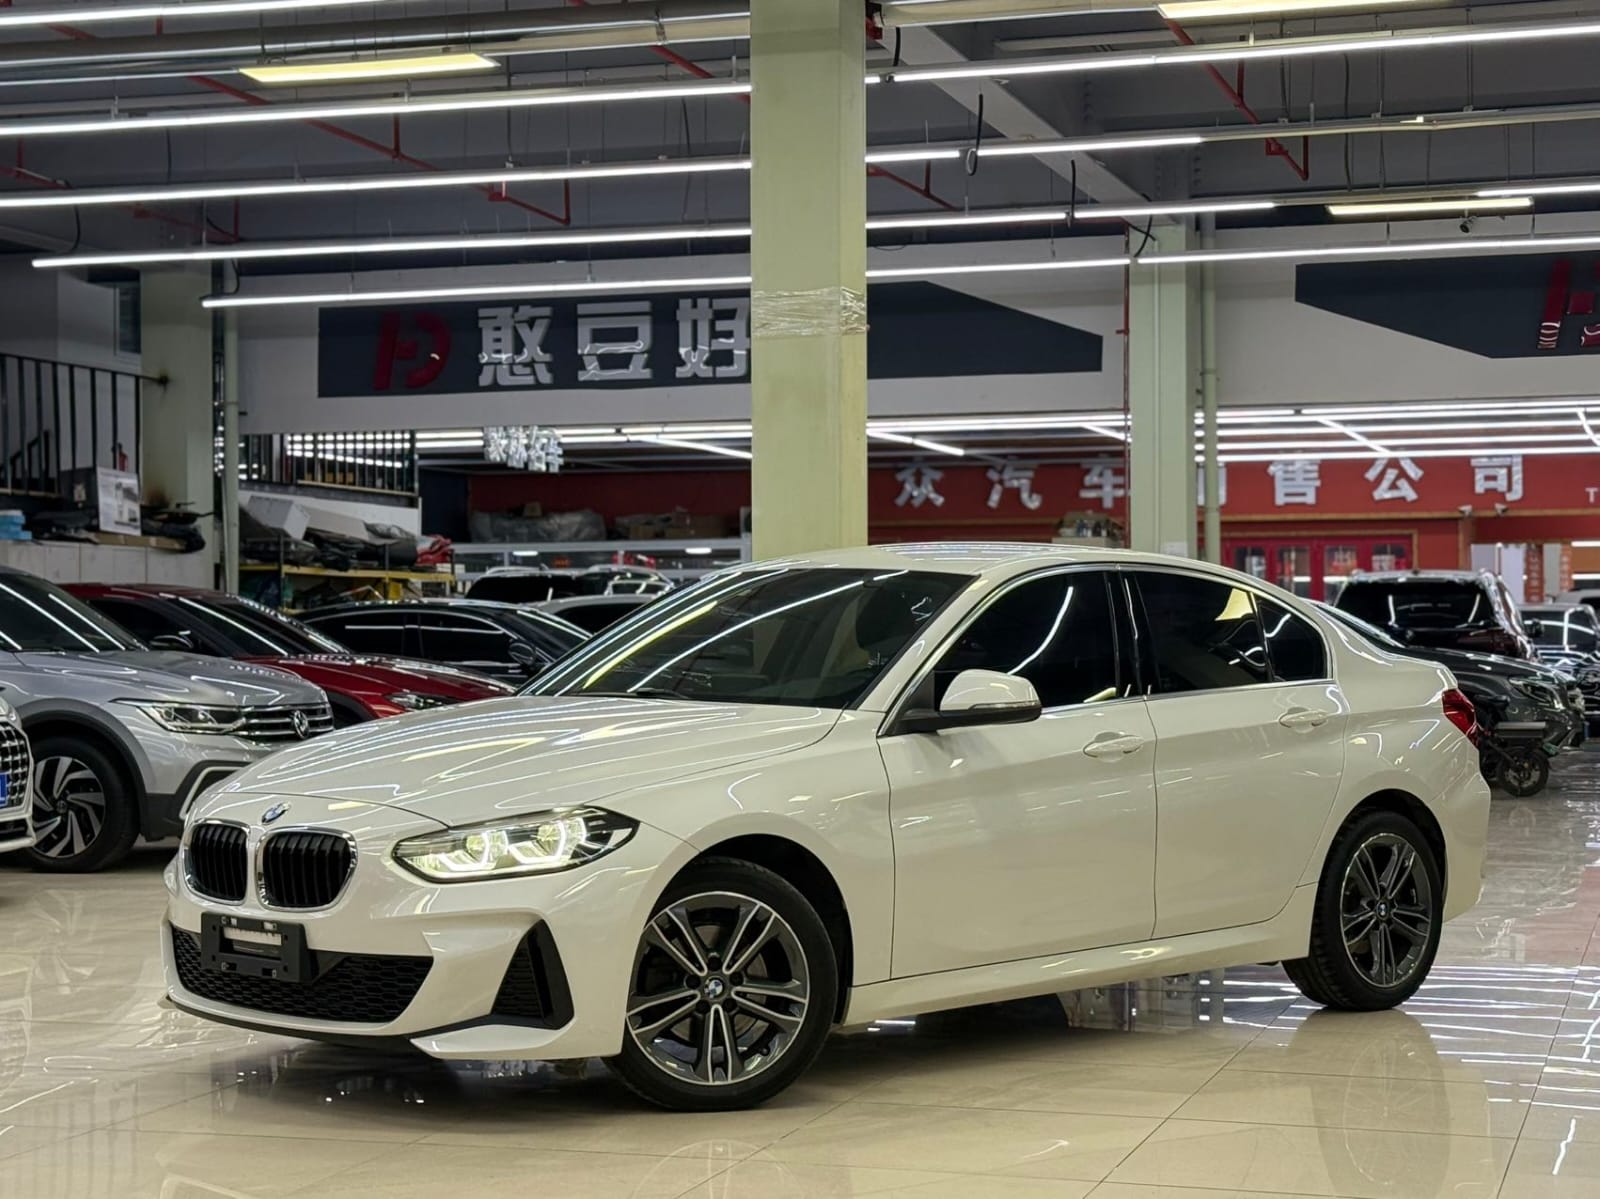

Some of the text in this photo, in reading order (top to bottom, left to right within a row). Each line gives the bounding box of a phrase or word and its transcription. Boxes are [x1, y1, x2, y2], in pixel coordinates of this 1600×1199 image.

[478, 297, 751, 385] 憨豆好
[895, 452, 1524, 509] 众汽车售公司
